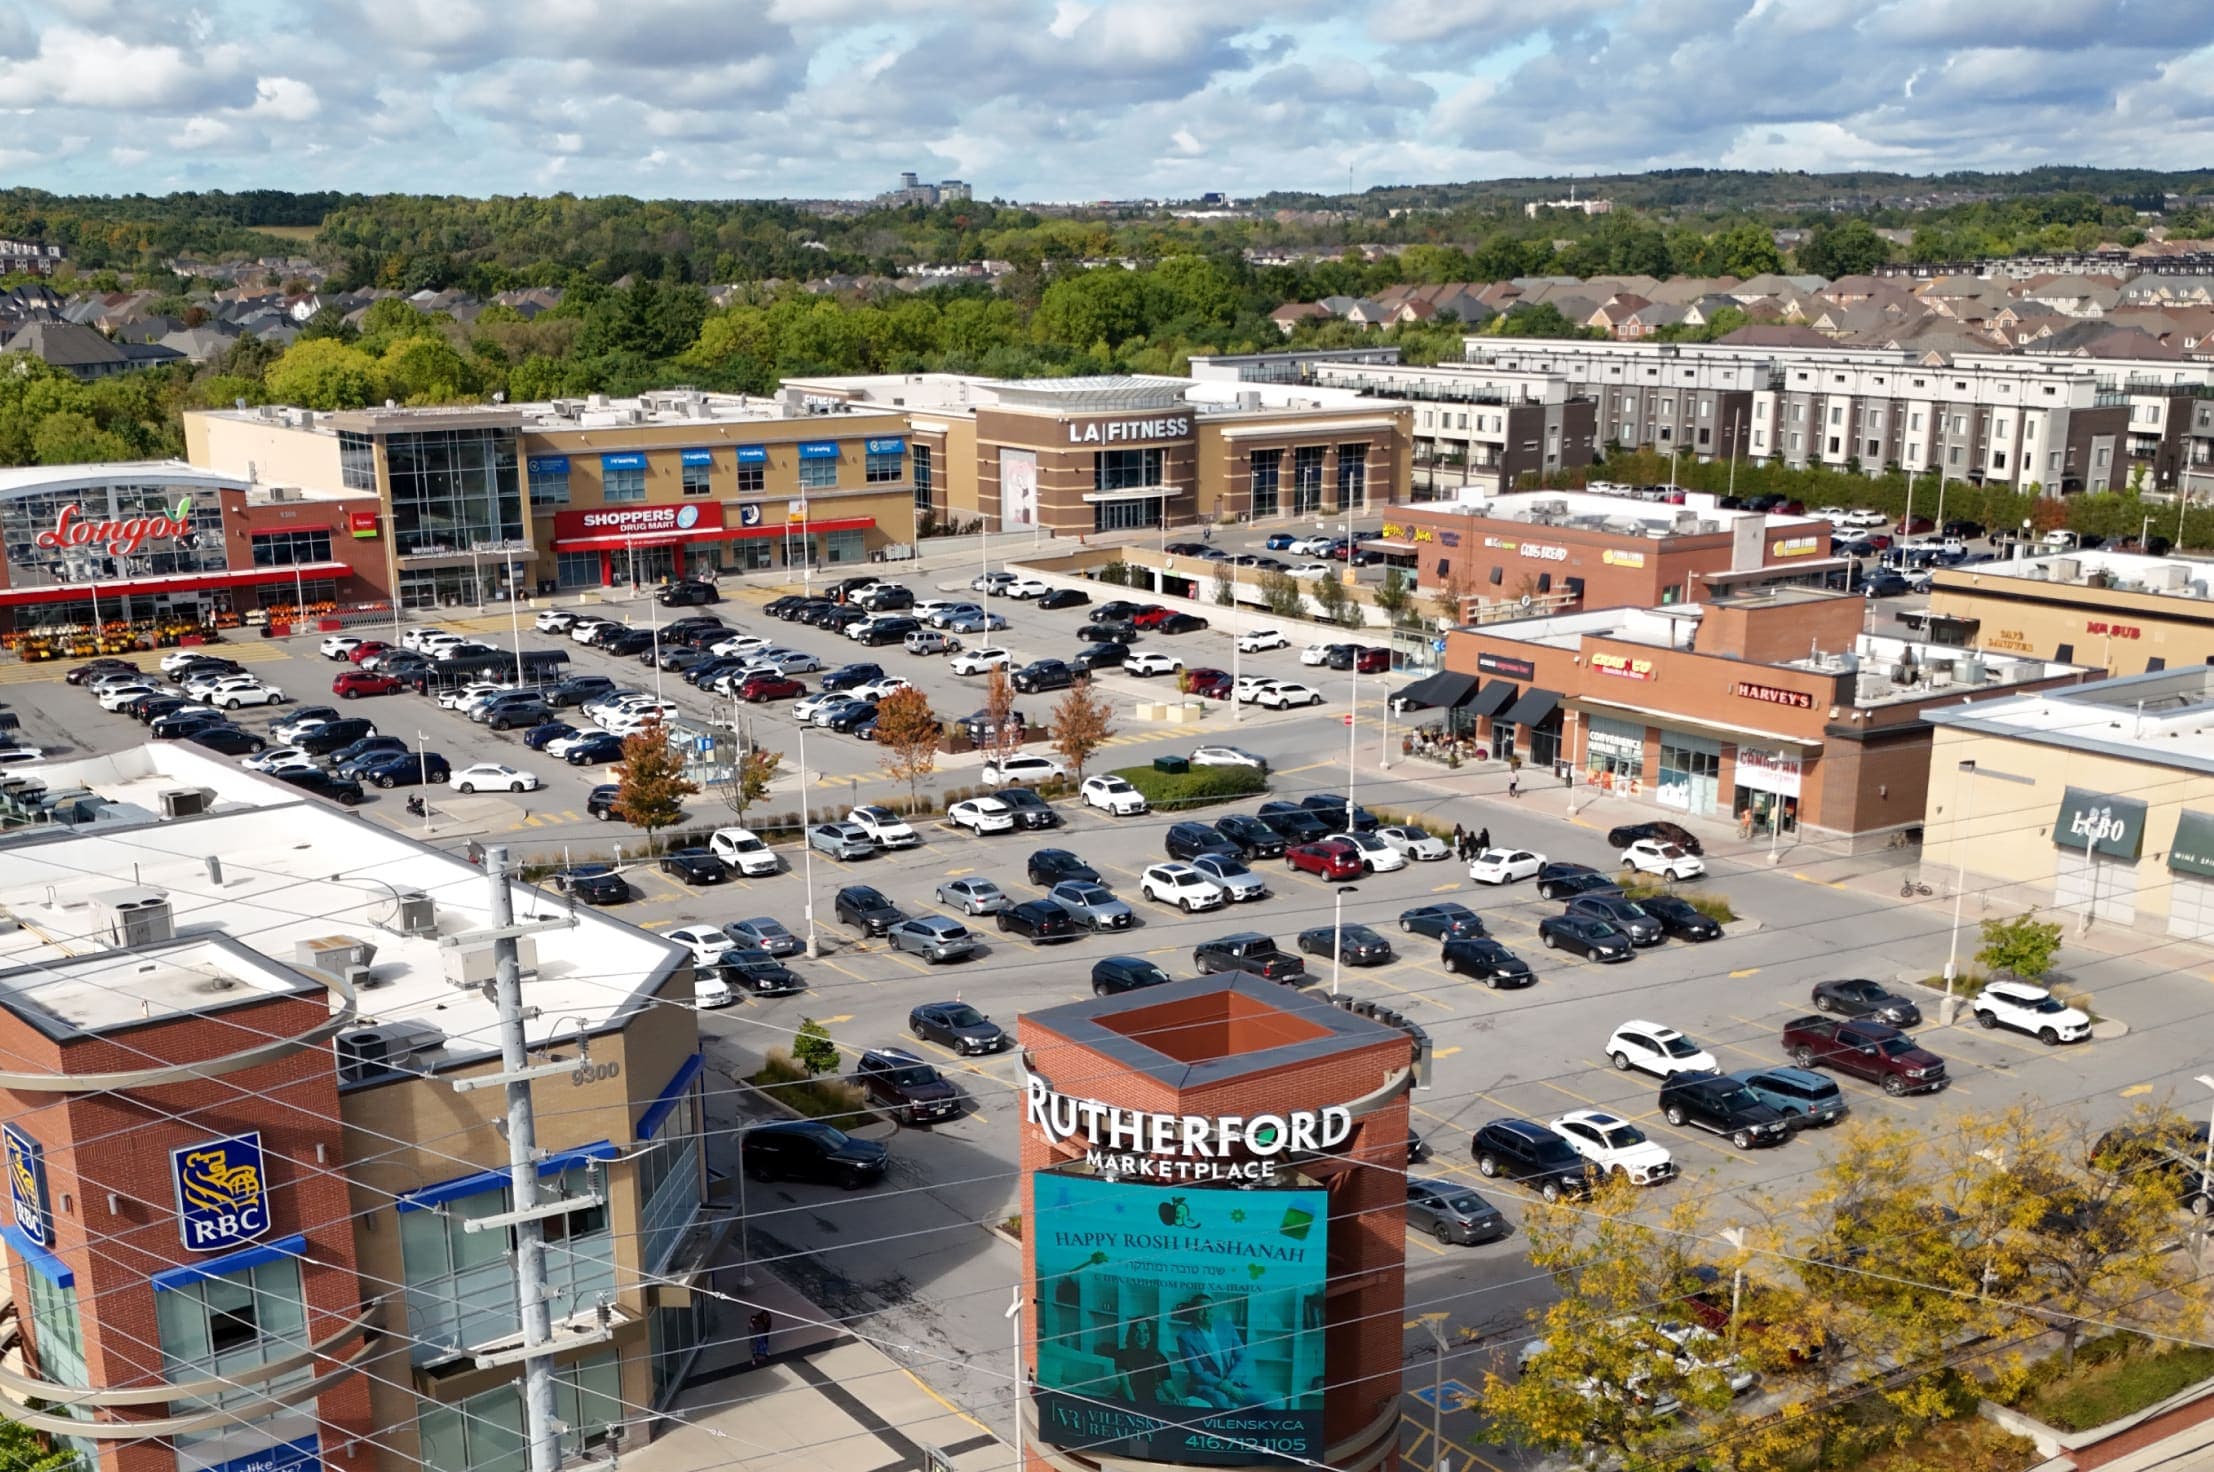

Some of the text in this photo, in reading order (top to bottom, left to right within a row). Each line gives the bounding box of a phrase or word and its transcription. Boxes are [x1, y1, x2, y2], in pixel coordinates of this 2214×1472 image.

[1069, 417, 1189, 442] LA FITNESS
[583, 508, 675, 527] SHOPPERS
[619, 520, 675, 533] DRUG MART
[1738, 683, 1810, 709] HARVEY'S
[2070, 810, 2125, 842] LCBO
[1027, 1073, 1351, 1158] RUTHERFORD
[1086, 1149, 1276, 1180] MARKETPLACE
[16, 1202, 42, 1238] RBC
[193, 1208, 261, 1244] RBC
[1055, 1231, 1305, 1264] HAPPY ROSH HASHANAH
[1087, 1409, 1164, 1431] VILENSKY
[1202, 1418, 1305, 1431] VILENSKY.CA
[1089, 1423, 1155, 1443] REALTY
[1184, 1434, 1307, 1451] 416.712.1105
